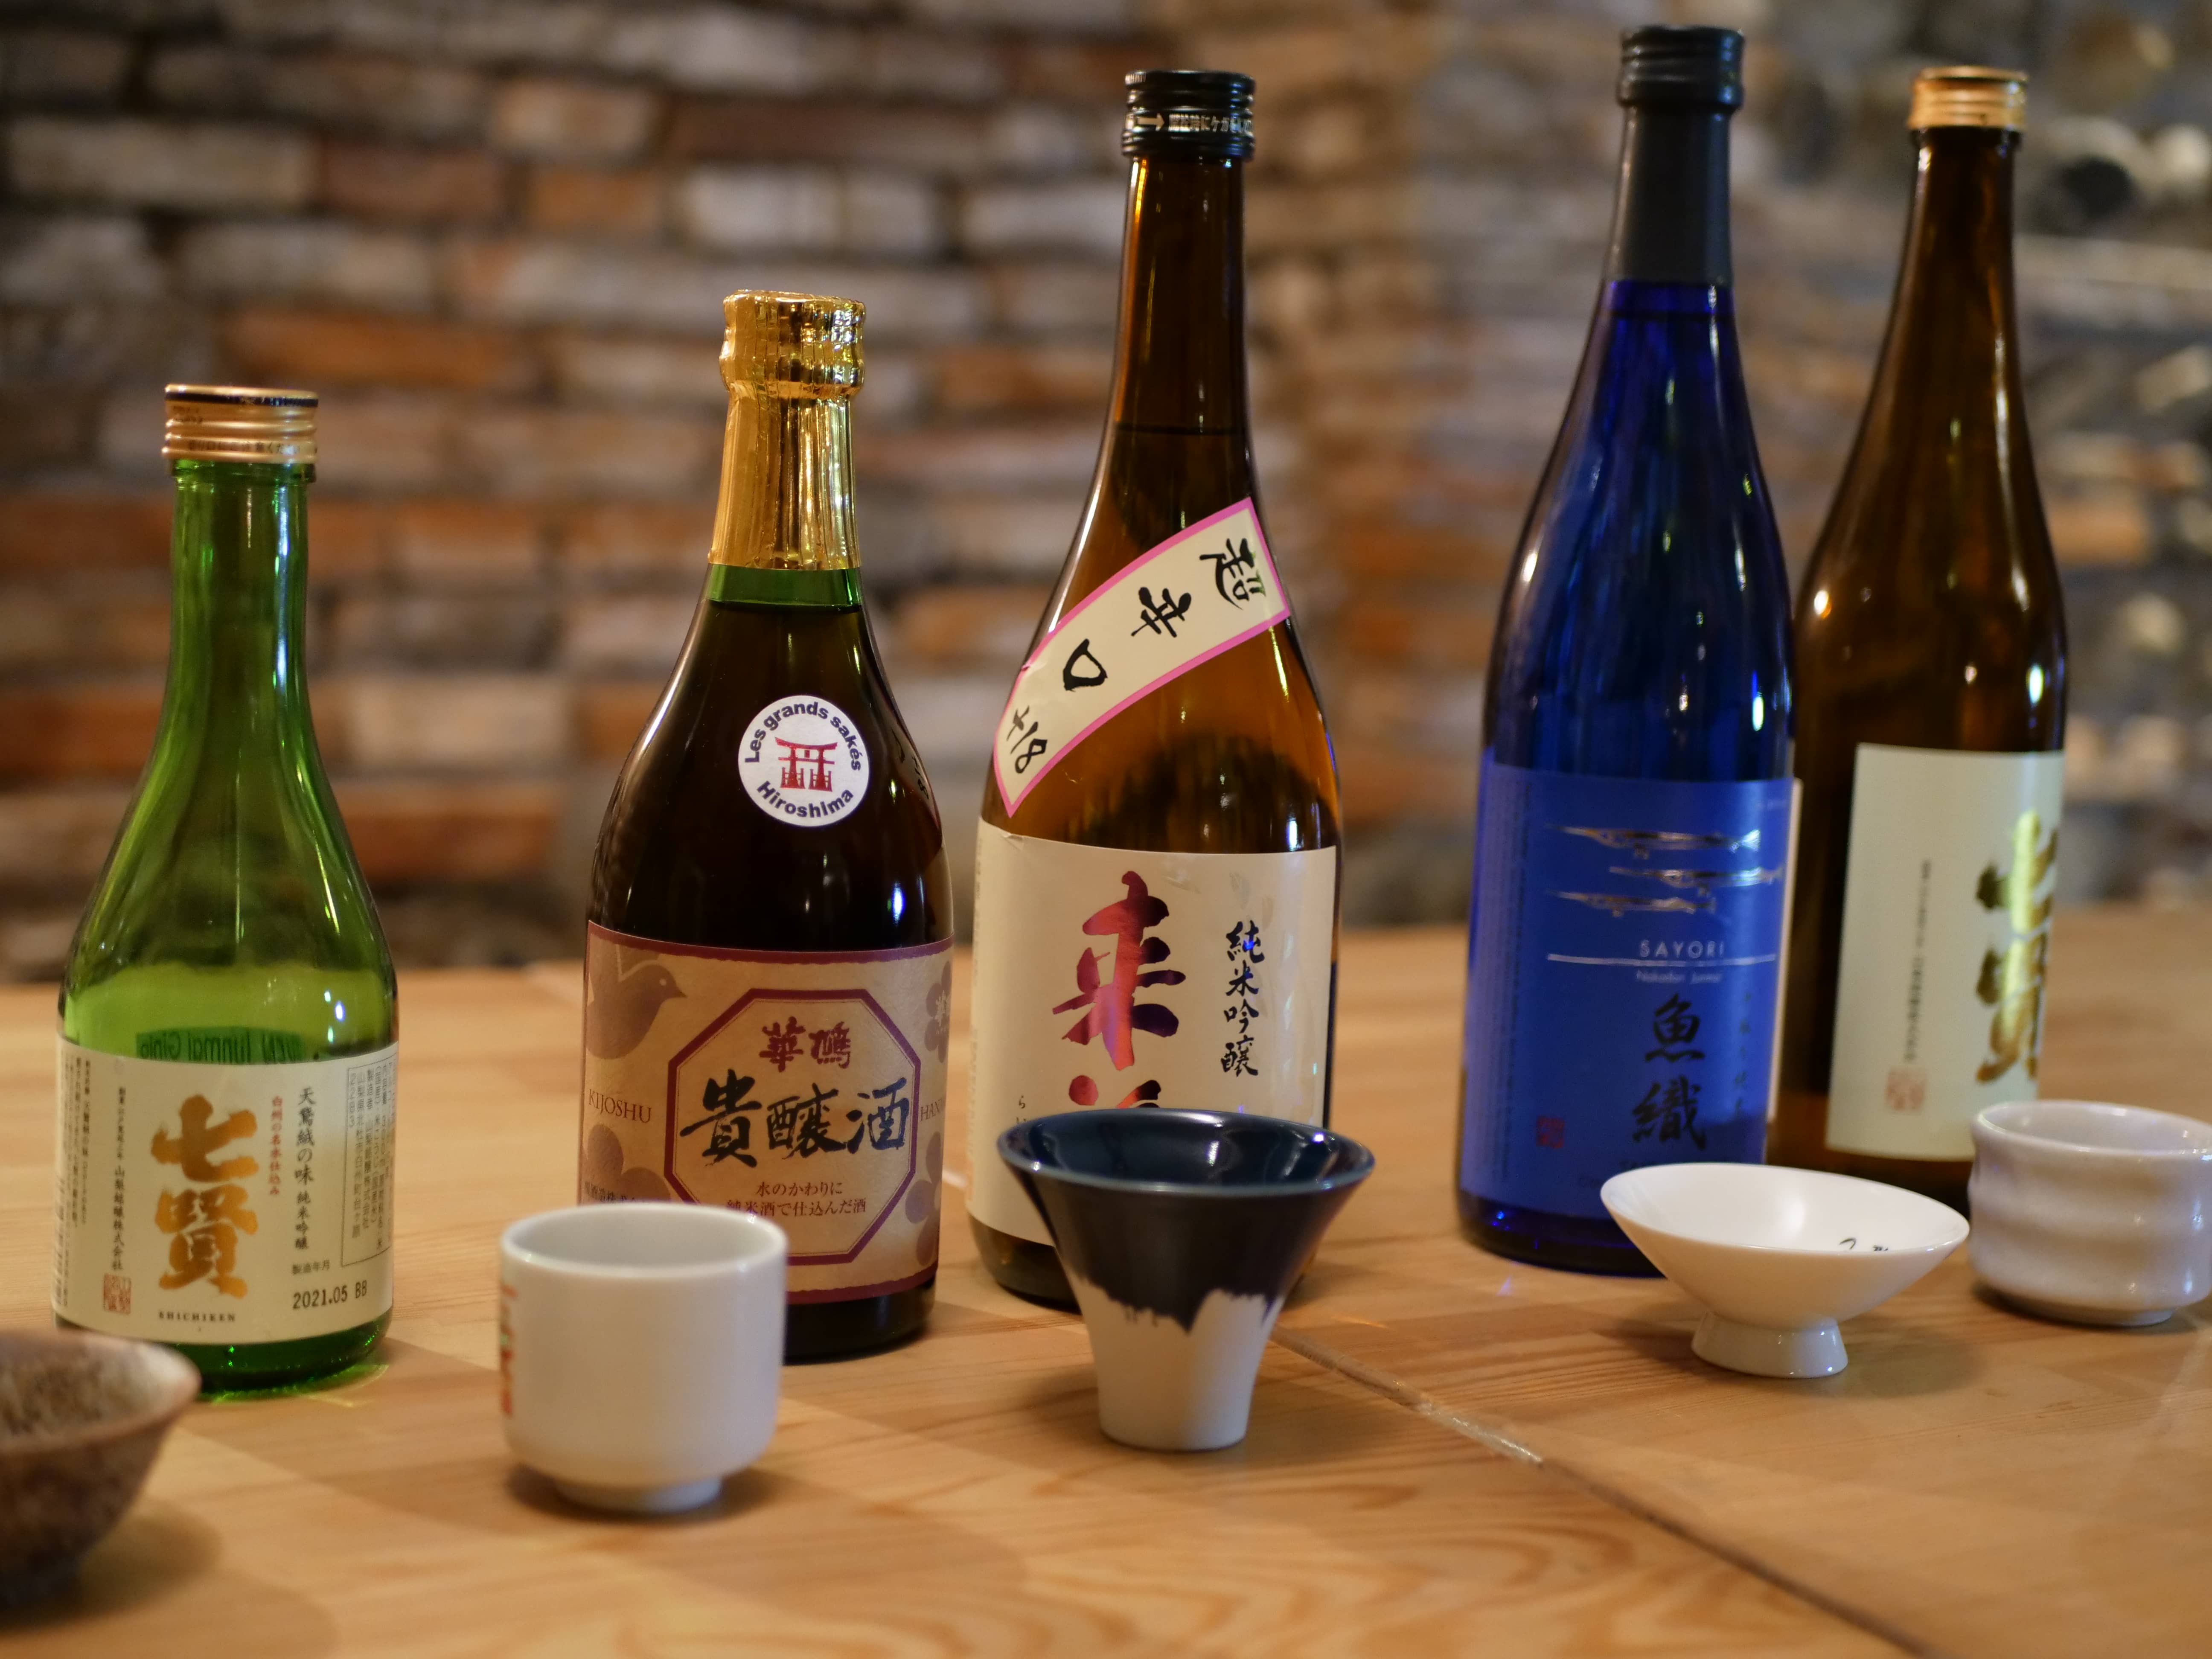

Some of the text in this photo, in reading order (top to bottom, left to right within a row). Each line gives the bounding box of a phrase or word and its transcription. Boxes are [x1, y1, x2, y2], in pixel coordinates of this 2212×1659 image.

[745, 701, 862, 771] Les grands sakés
[757, 780, 854, 818] Hiroshima
[1640, 940, 1724, 958] SAYORI
[1220, 920, 1265, 1077] 純米吟醸
[588, 1089, 652, 1123] KIJOSHU
[680, 1069, 909, 1168] 貴醸酒
[150, 1094, 259, 1300] 七賢
[757, 1181, 843, 1197] 水のかわりに
[294, 1190, 311, 1250] 純米吟醸
[727, 1198, 866, 1217] 純米酒で仕込んだ酒
[292, 1285, 348, 1310] 2021.05
[158, 1310, 236, 1322] SHICHIKEN
